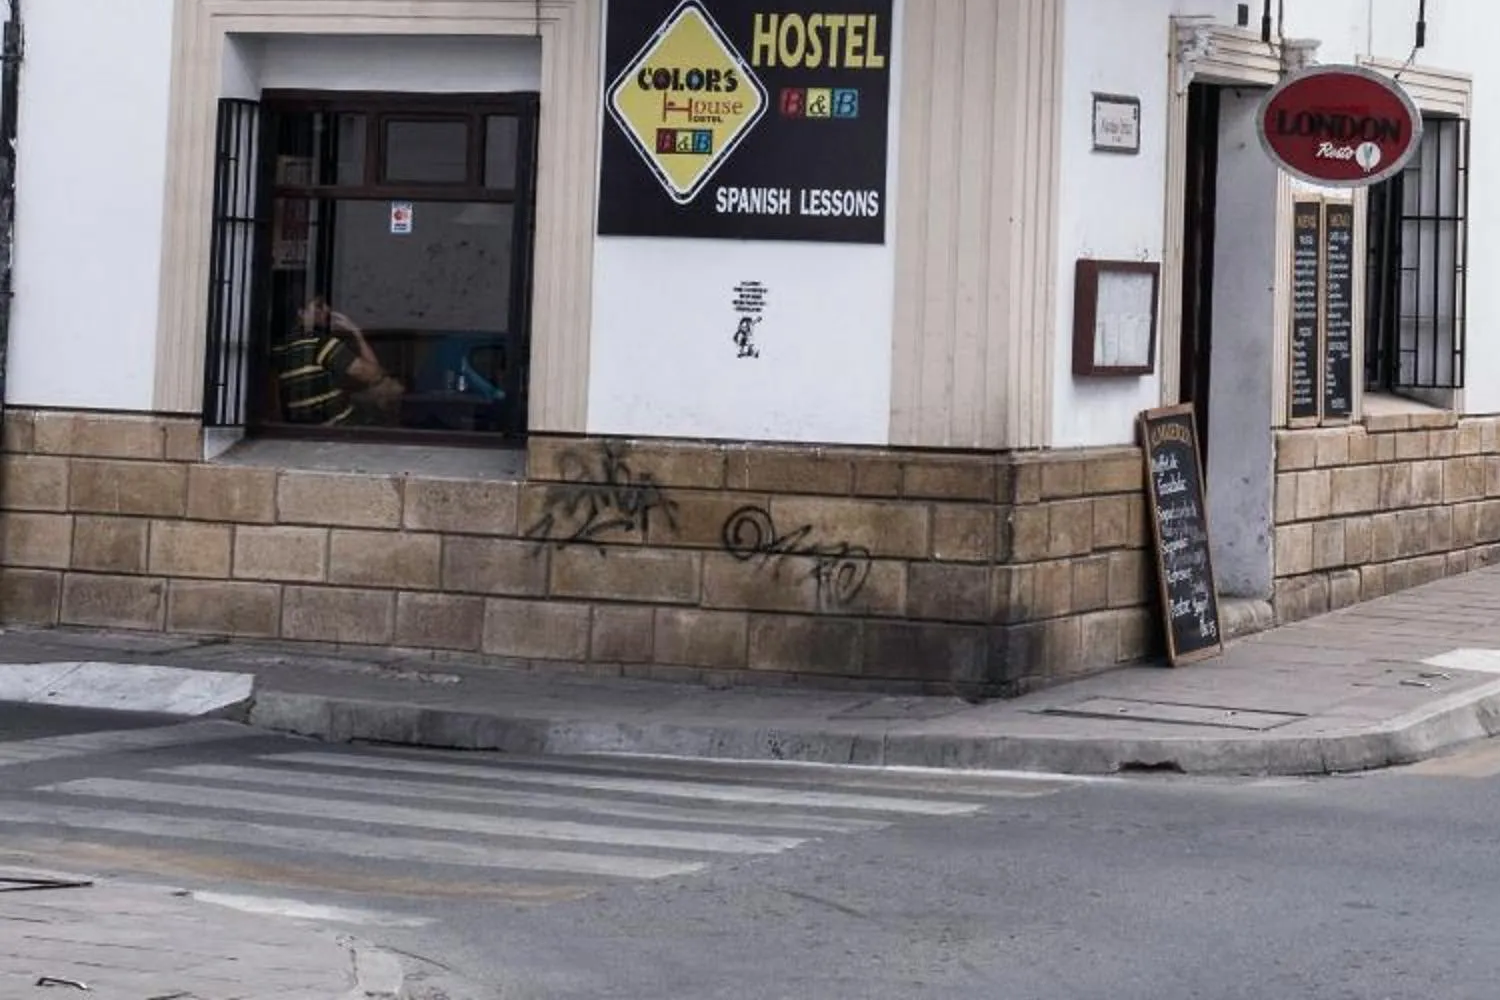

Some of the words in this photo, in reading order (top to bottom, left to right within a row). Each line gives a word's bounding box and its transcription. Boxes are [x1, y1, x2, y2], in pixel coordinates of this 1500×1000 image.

[752, 13, 885, 69] HOSTEL
[637, 67, 738, 92] COLORS
[1276, 108, 1401, 143] LONDON
[715, 186, 791, 215] SPANISH
[800, 189, 879, 217] LESSONS
